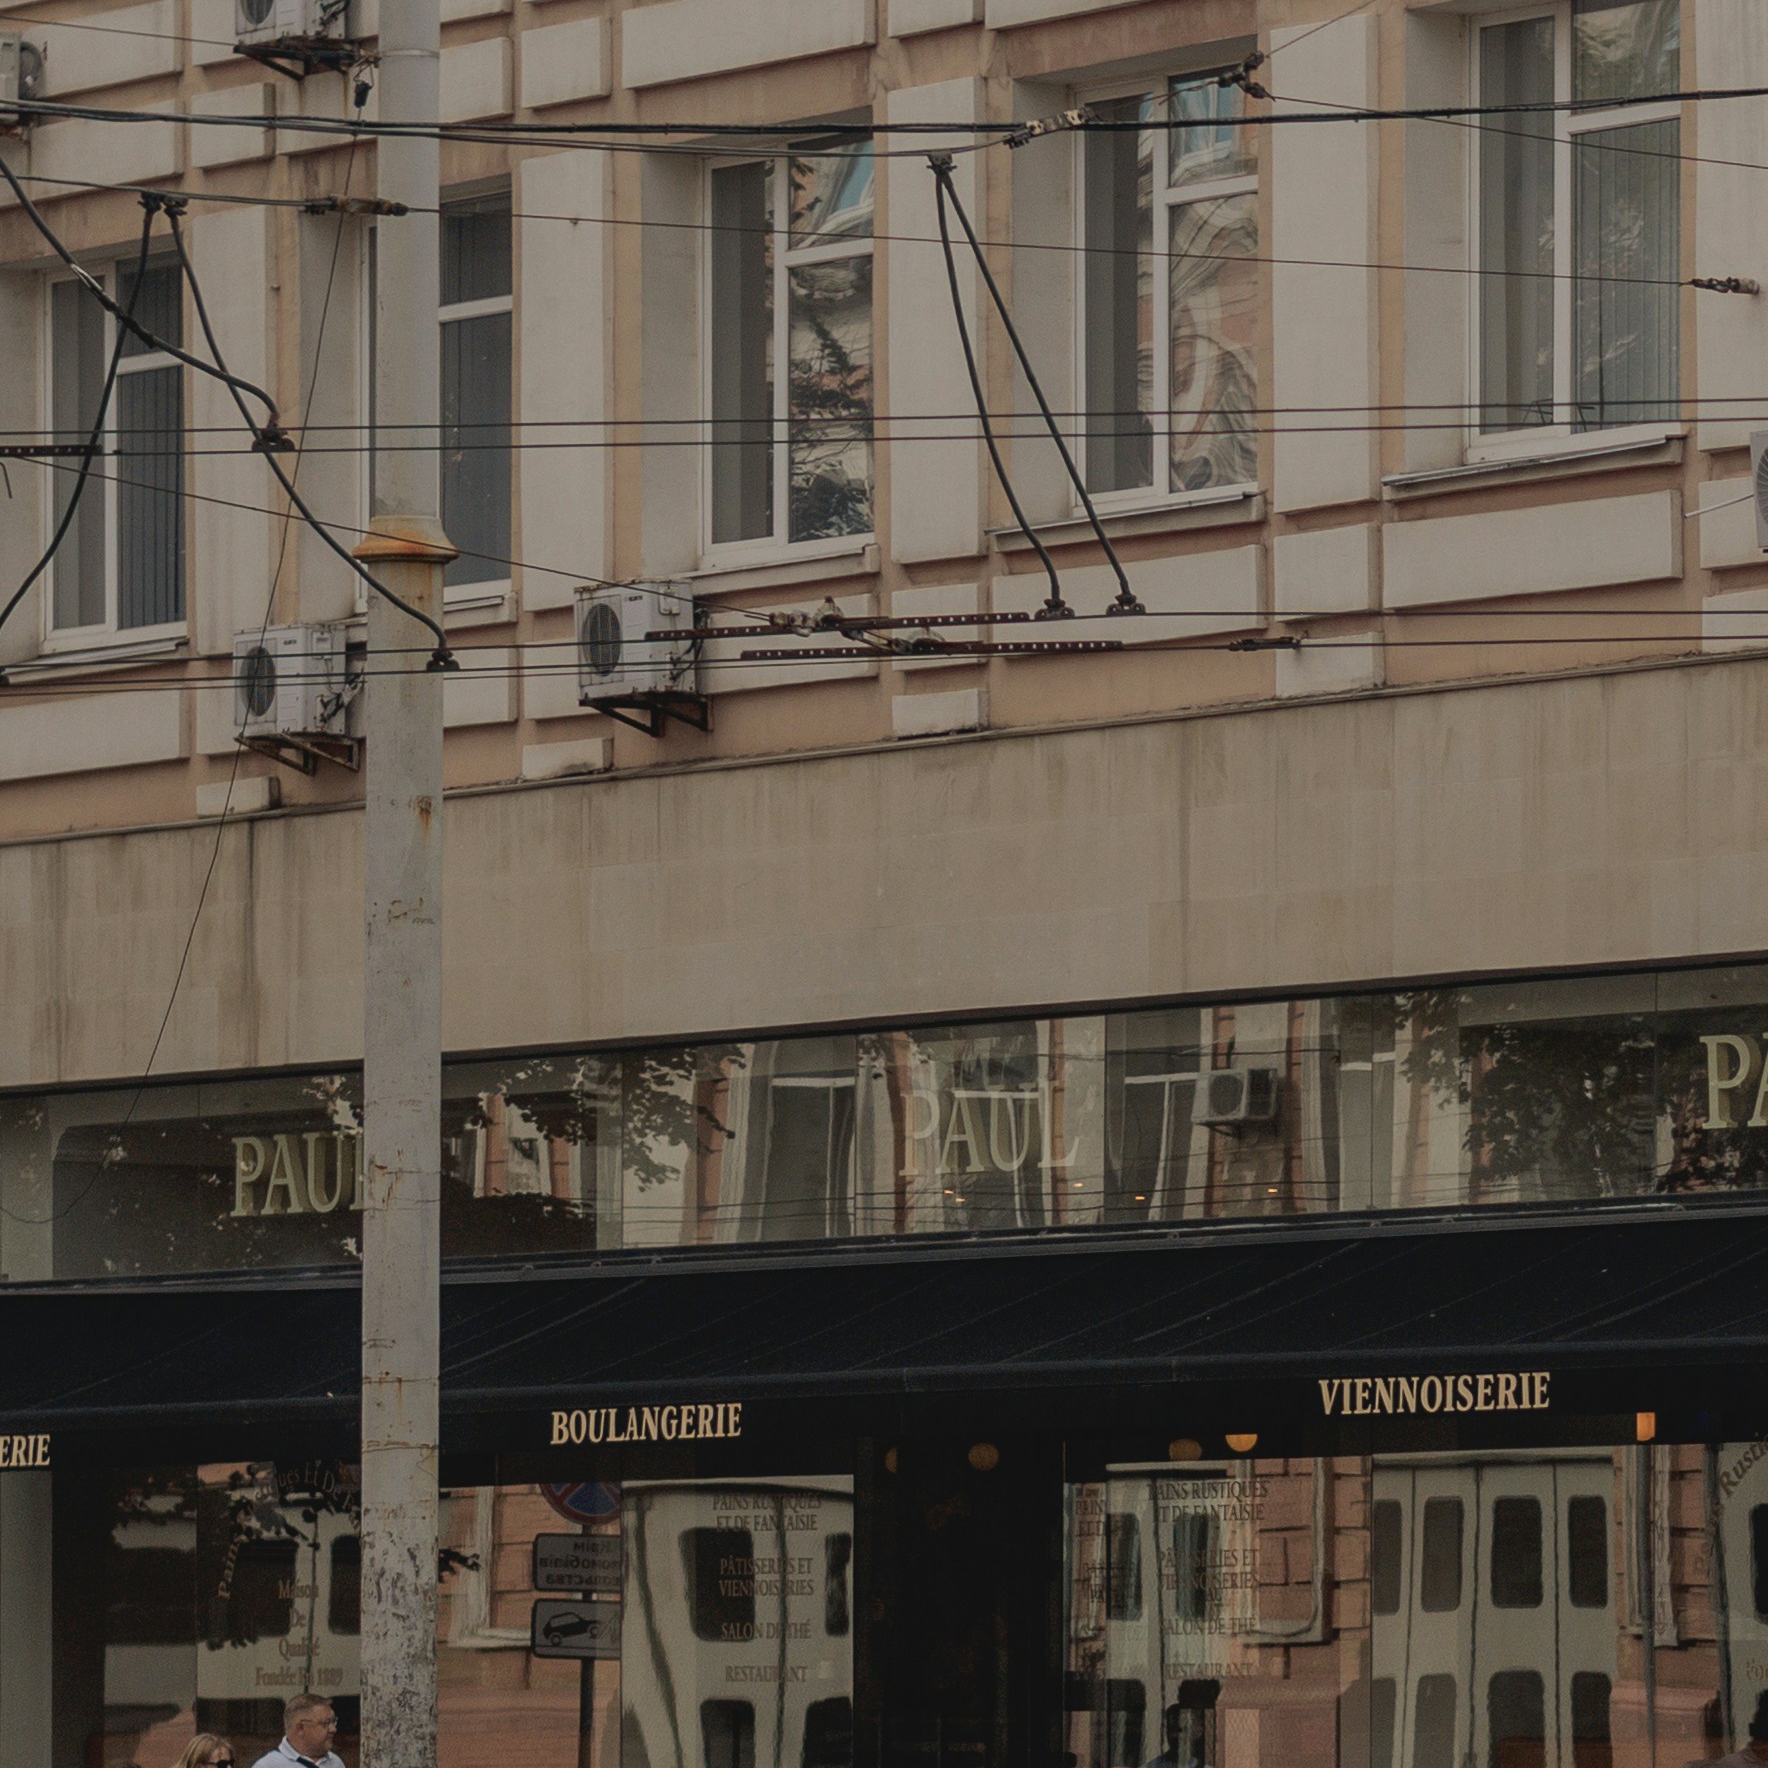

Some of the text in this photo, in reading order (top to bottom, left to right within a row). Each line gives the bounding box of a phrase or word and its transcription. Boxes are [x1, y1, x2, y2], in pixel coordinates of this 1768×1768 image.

[899, 1081, 1080, 1176] PAUL
[1318, 1371, 1551, 1415] VIENNOISERIE
[551, 1402, 742, 1445] BOULANGERIE
[0, 1433, 51, 1467] ERIE
[719, 1554, 795, 1575] PÂTISSERIS
[718, 1579, 814, 1597] VIENNOISRIES
